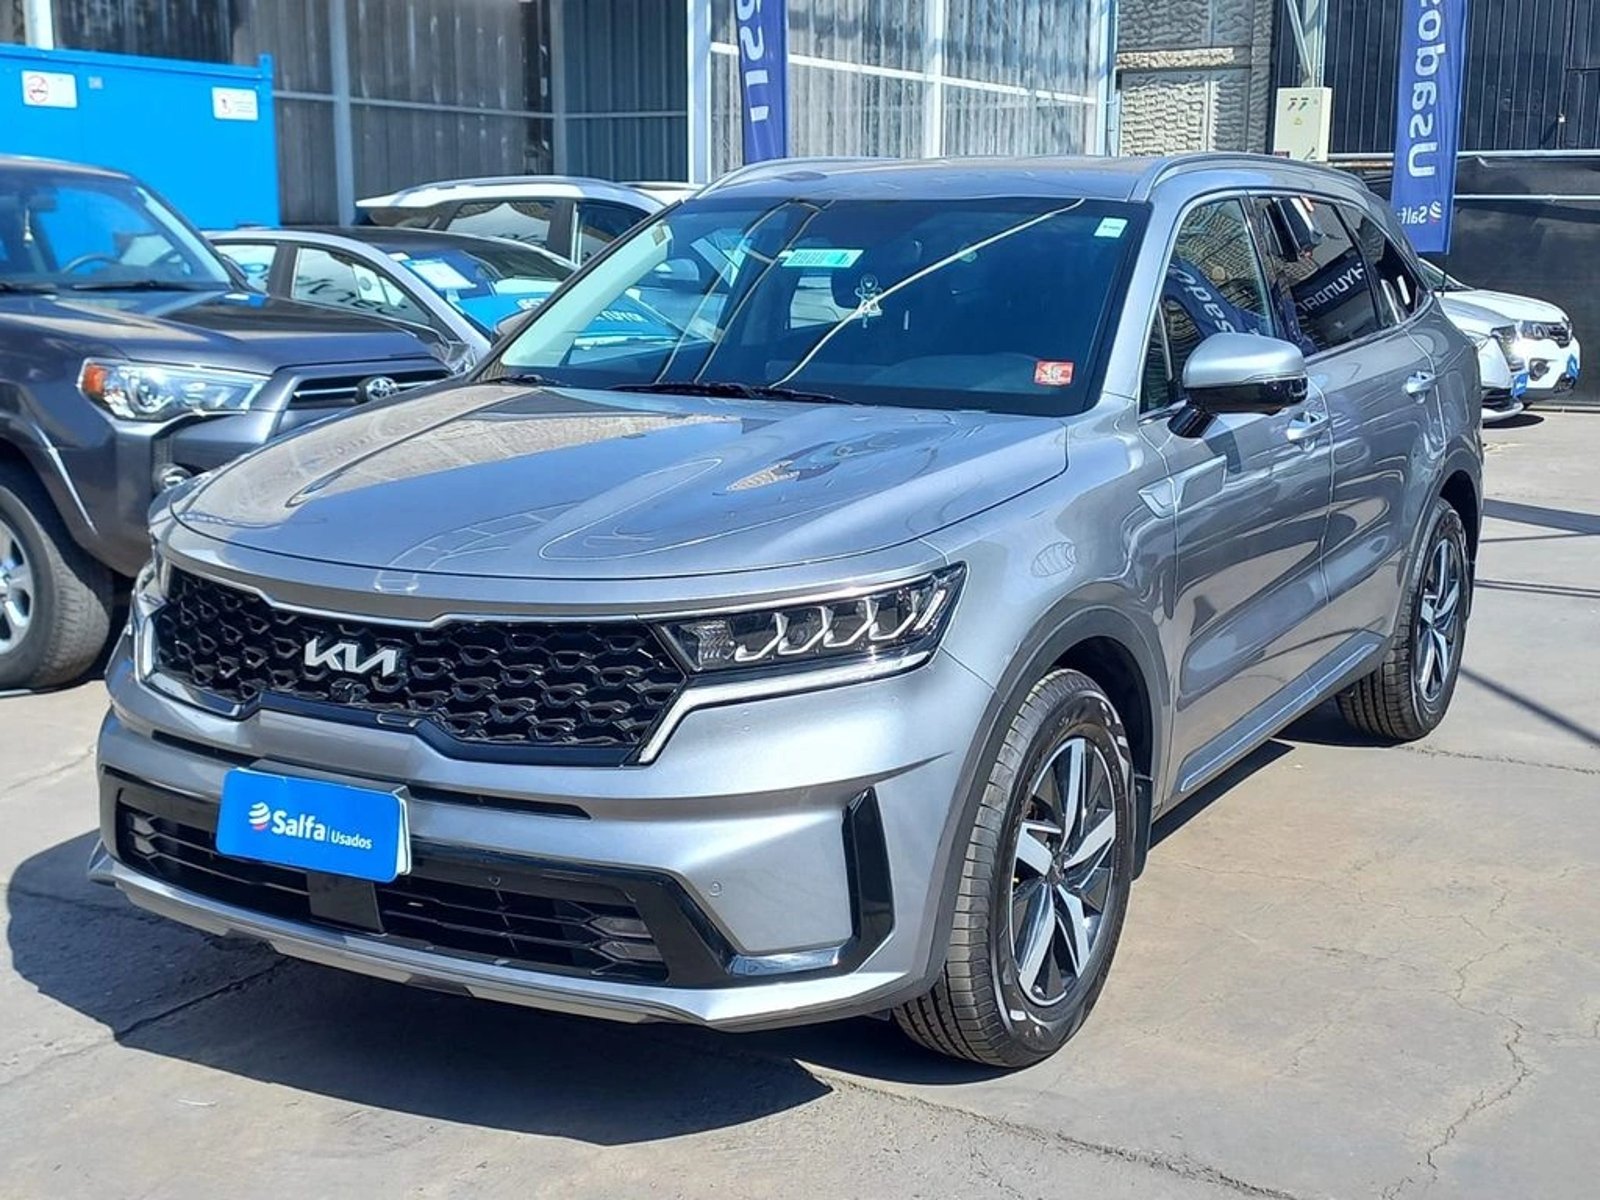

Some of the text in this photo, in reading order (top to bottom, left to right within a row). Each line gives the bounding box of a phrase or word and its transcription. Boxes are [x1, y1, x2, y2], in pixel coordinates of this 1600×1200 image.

[304, 637, 397, 678] KIA
[271, 809, 374, 851] Salfa Usados
